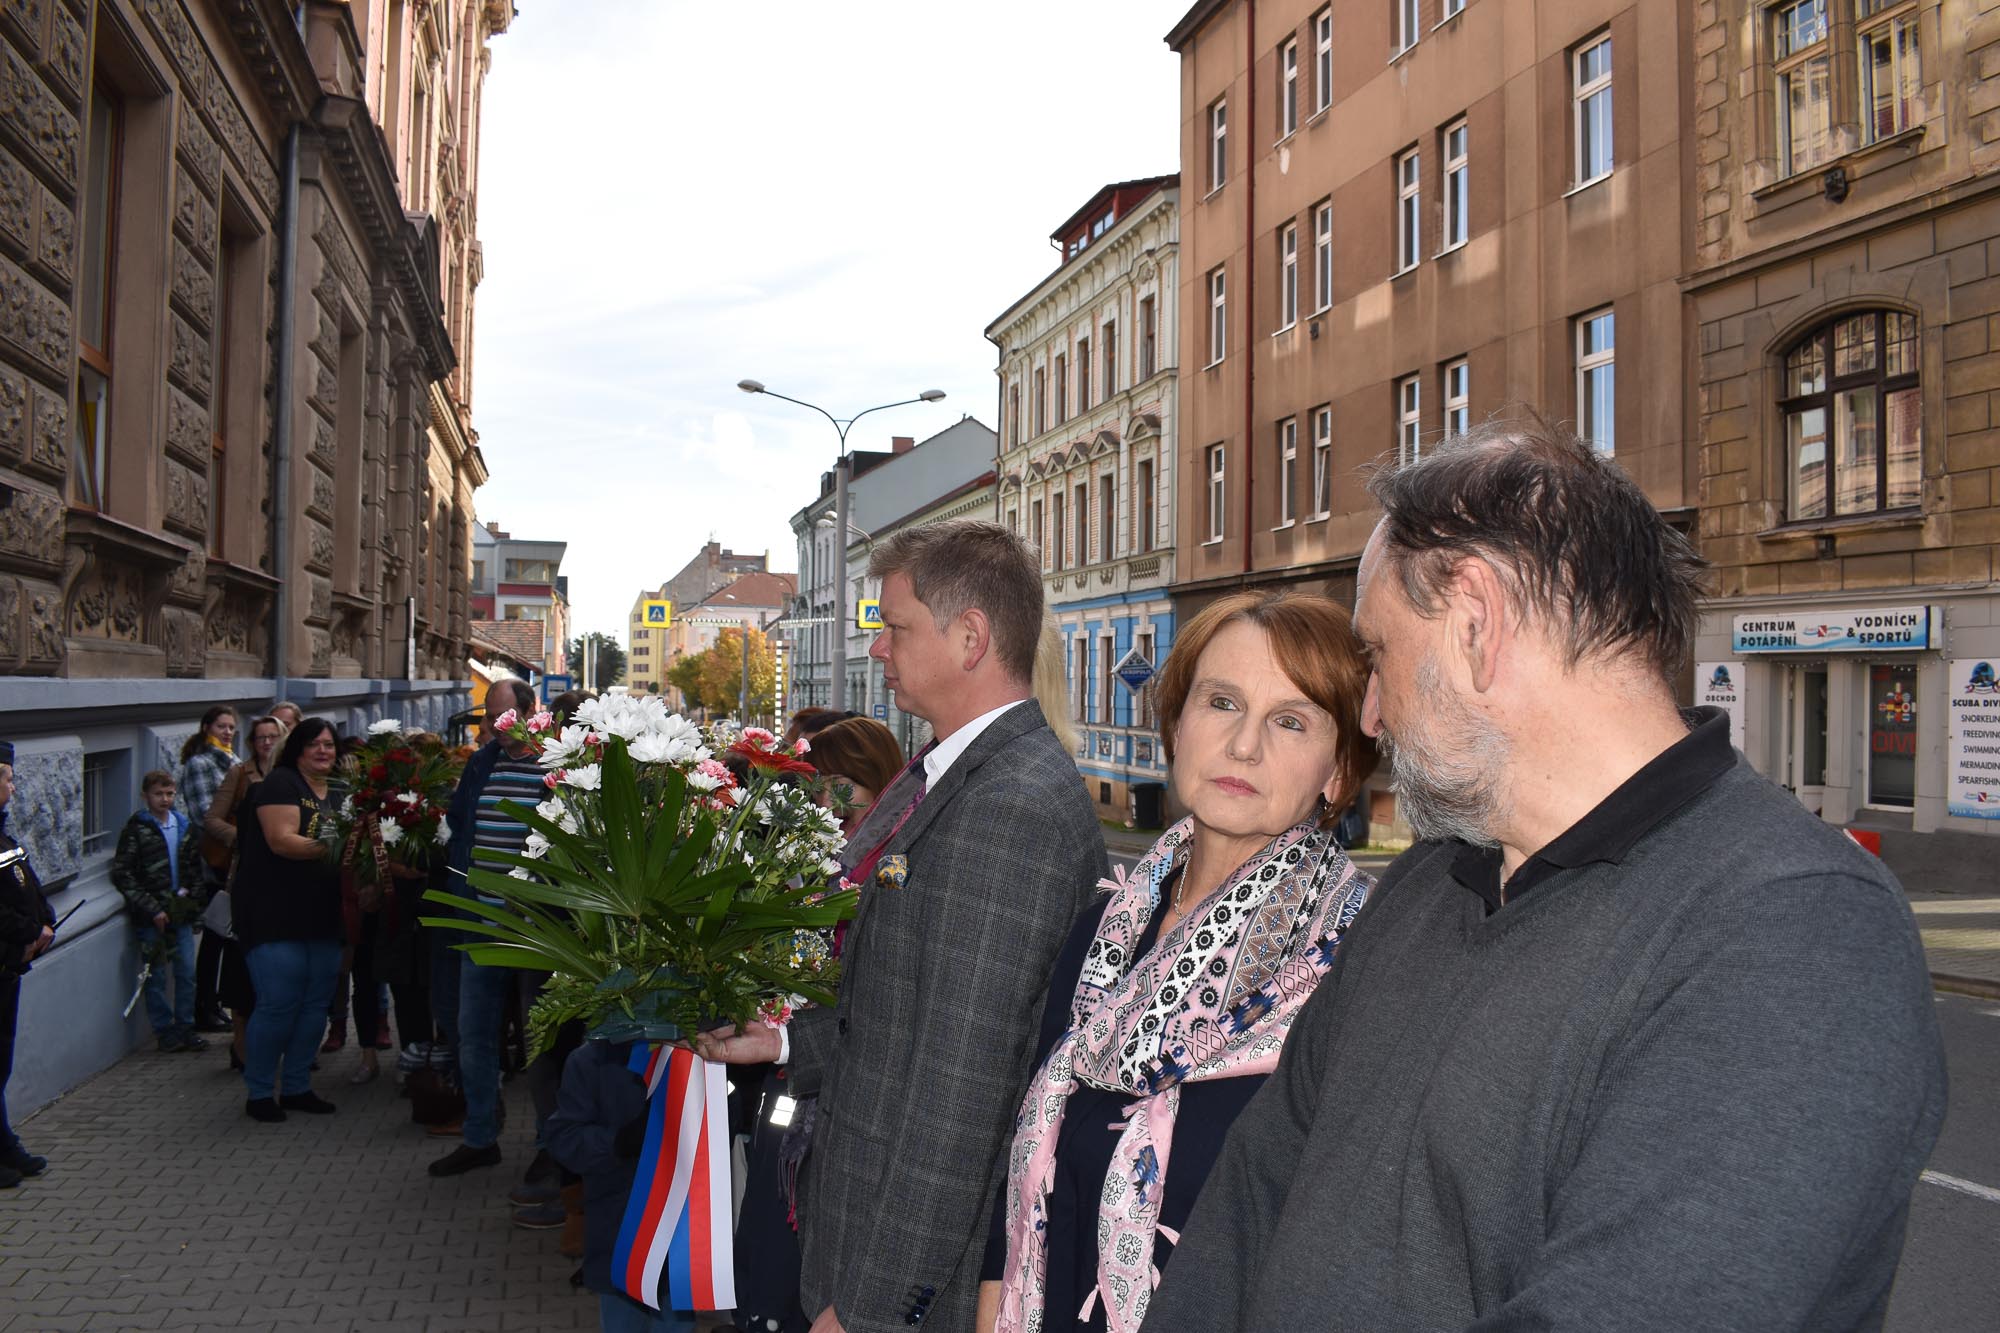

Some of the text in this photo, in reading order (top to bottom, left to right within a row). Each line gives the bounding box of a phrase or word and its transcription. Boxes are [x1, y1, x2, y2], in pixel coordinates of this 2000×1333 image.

[1742, 621, 1796, 632] CENTRUM
[1854, 612, 1917, 628] VODNÍCH
[1740, 633, 1797, 647] POTÁPĚNÍ
[1846, 627, 1856, 638] &
[1859, 628, 1912, 644] SPORTŮ
[1952, 699, 1980, 707] SCUBA
